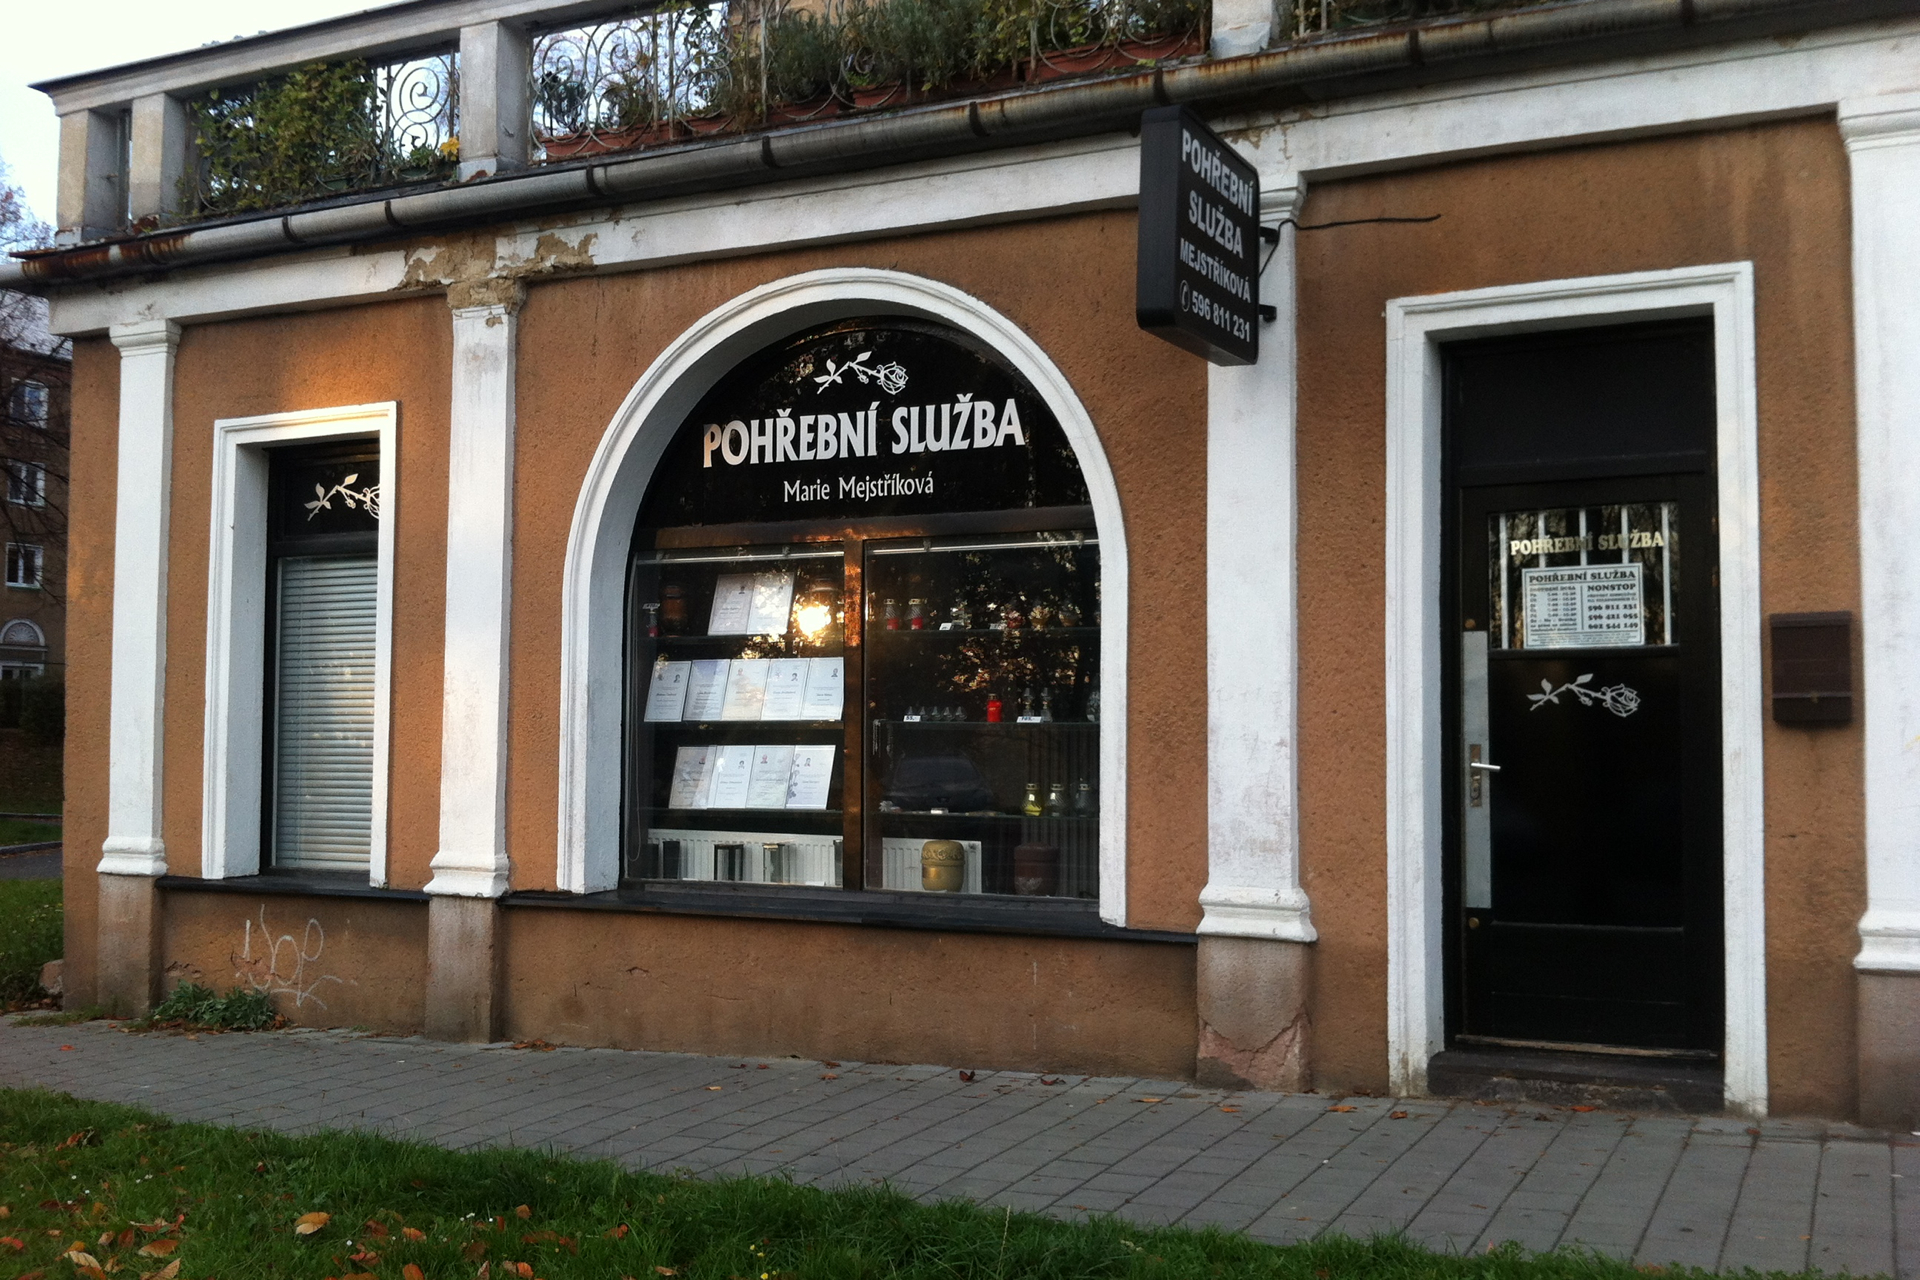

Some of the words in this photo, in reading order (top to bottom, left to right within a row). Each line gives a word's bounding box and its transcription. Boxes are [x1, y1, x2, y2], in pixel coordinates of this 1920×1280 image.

[1181, 128, 1254, 217] POHŘEBNÍ
[1188, 189, 1244, 259] SLUŽBA
[1180, 237, 1252, 303] MEJSTŘÍKOVÁ
[1191, 290, 1211, 320] 596
[1213, 302, 1231, 332] 811
[1233, 313, 1251, 343] 231
[703, 401, 881, 468] POHŘEBNÍ
[891, 392, 1026, 455] SLUŽBA
[783, 480, 831, 503] Marie
[838, 470, 934, 503] Mejstříková
[1510, 534, 1593, 555] POHŘEBNÍ
[1598, 530, 1664, 550] SLUŽBA
[1529, 572, 1587, 583] POHŘEBNÍ
[1591, 570, 1636, 580] SLUŽBA
[1587, 583, 1636, 591] NONSTOP
